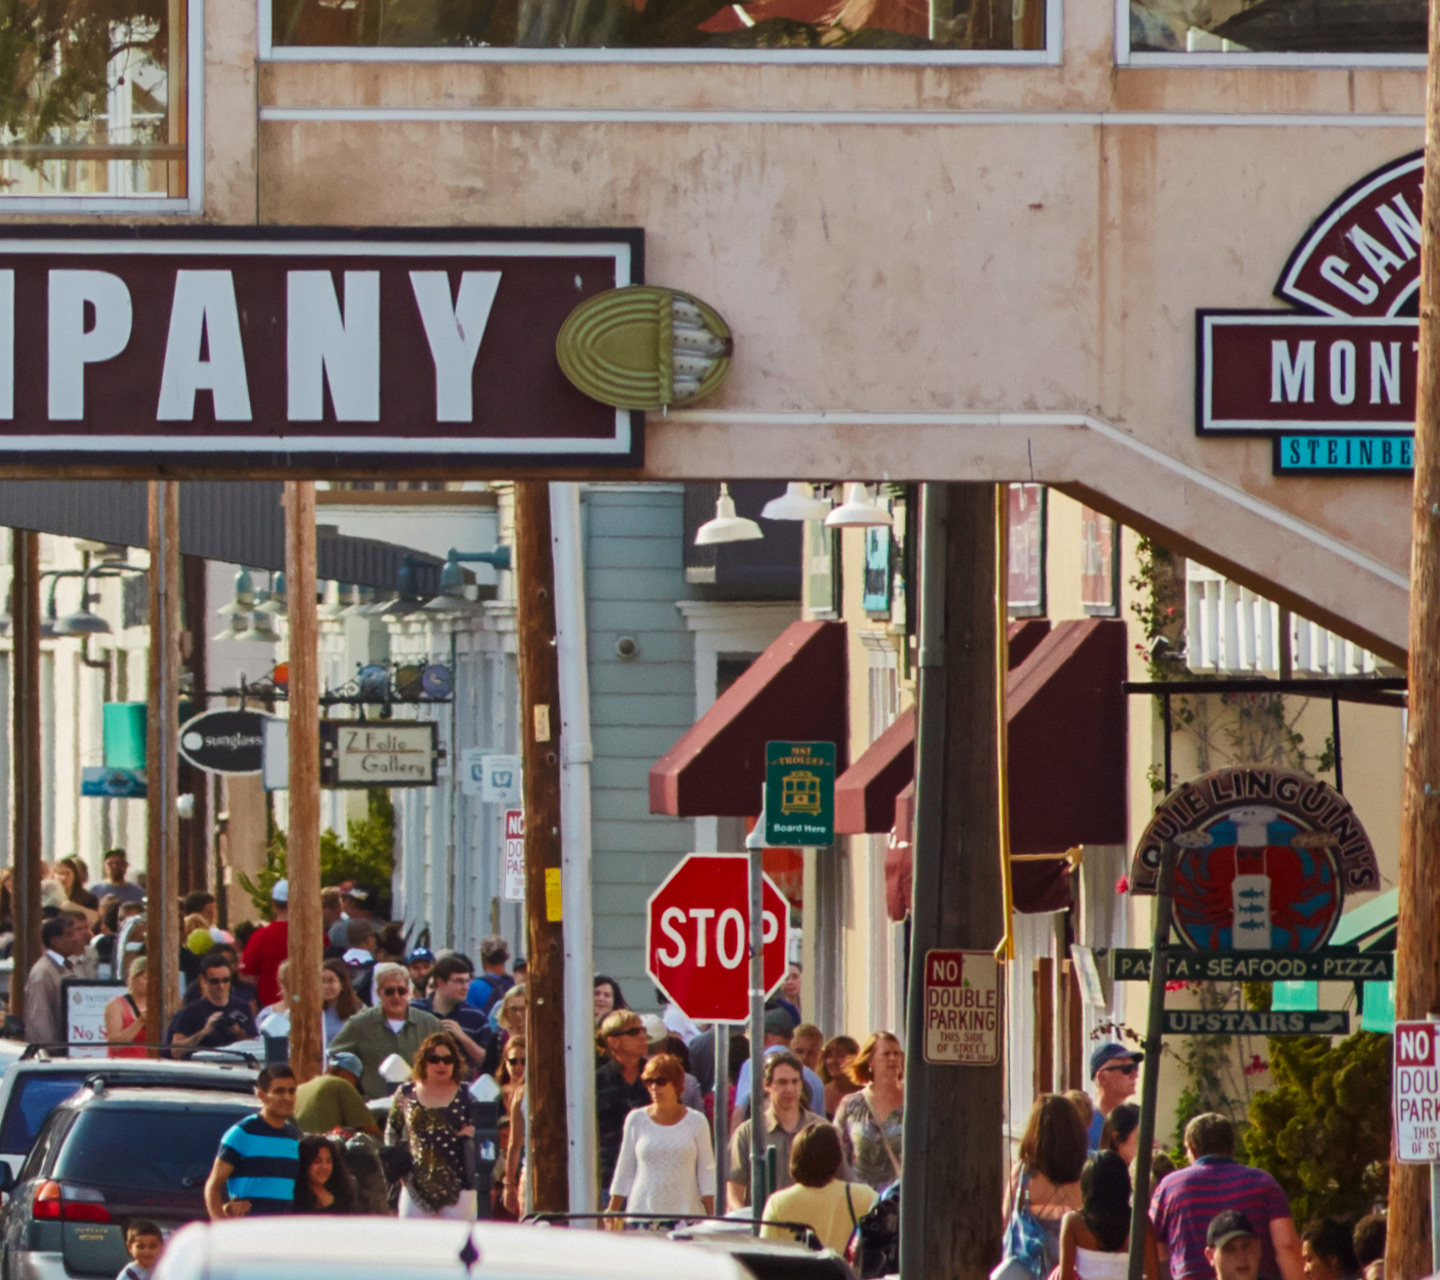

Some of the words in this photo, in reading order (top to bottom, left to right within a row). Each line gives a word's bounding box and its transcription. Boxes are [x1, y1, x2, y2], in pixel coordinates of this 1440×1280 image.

[1319, 183, 1422, 306] CAN
[1270, 339, 1419, 405] MON
[346, 731, 359, 751] Z
[361, 755, 426, 777] Gallery
[773, 823, 803, 833] Board
[803, 823, 827, 834] Here
[1135, 789, 1210, 892] LOUIE
[1210, 771, 1376, 888] LINGUINI'S
[657, 906, 779, 970] STOP
[932, 960, 959, 982] NO
[1208, 958, 1307, 977] SEAFOOD
[1323, 958, 1388, 977] PIZZA
[928, 988, 996, 1009] DOUBLE
[928, 1008, 996, 1032] PARKING
[1168, 1013, 1306, 1033] UPSTAIRS
[72, 1024, 94, 1041] No
[939, 1031, 960, 1042] THIS
[963, 1031, 985, 1043] SIDE
[936, 1043, 949, 1054] OF
[952, 1043, 987, 1055] STREET
[1400, 1030, 1430, 1061] NO
[1412, 1125, 1437, 1141] THIS
[1411, 1141, 1423, 1155] OF
